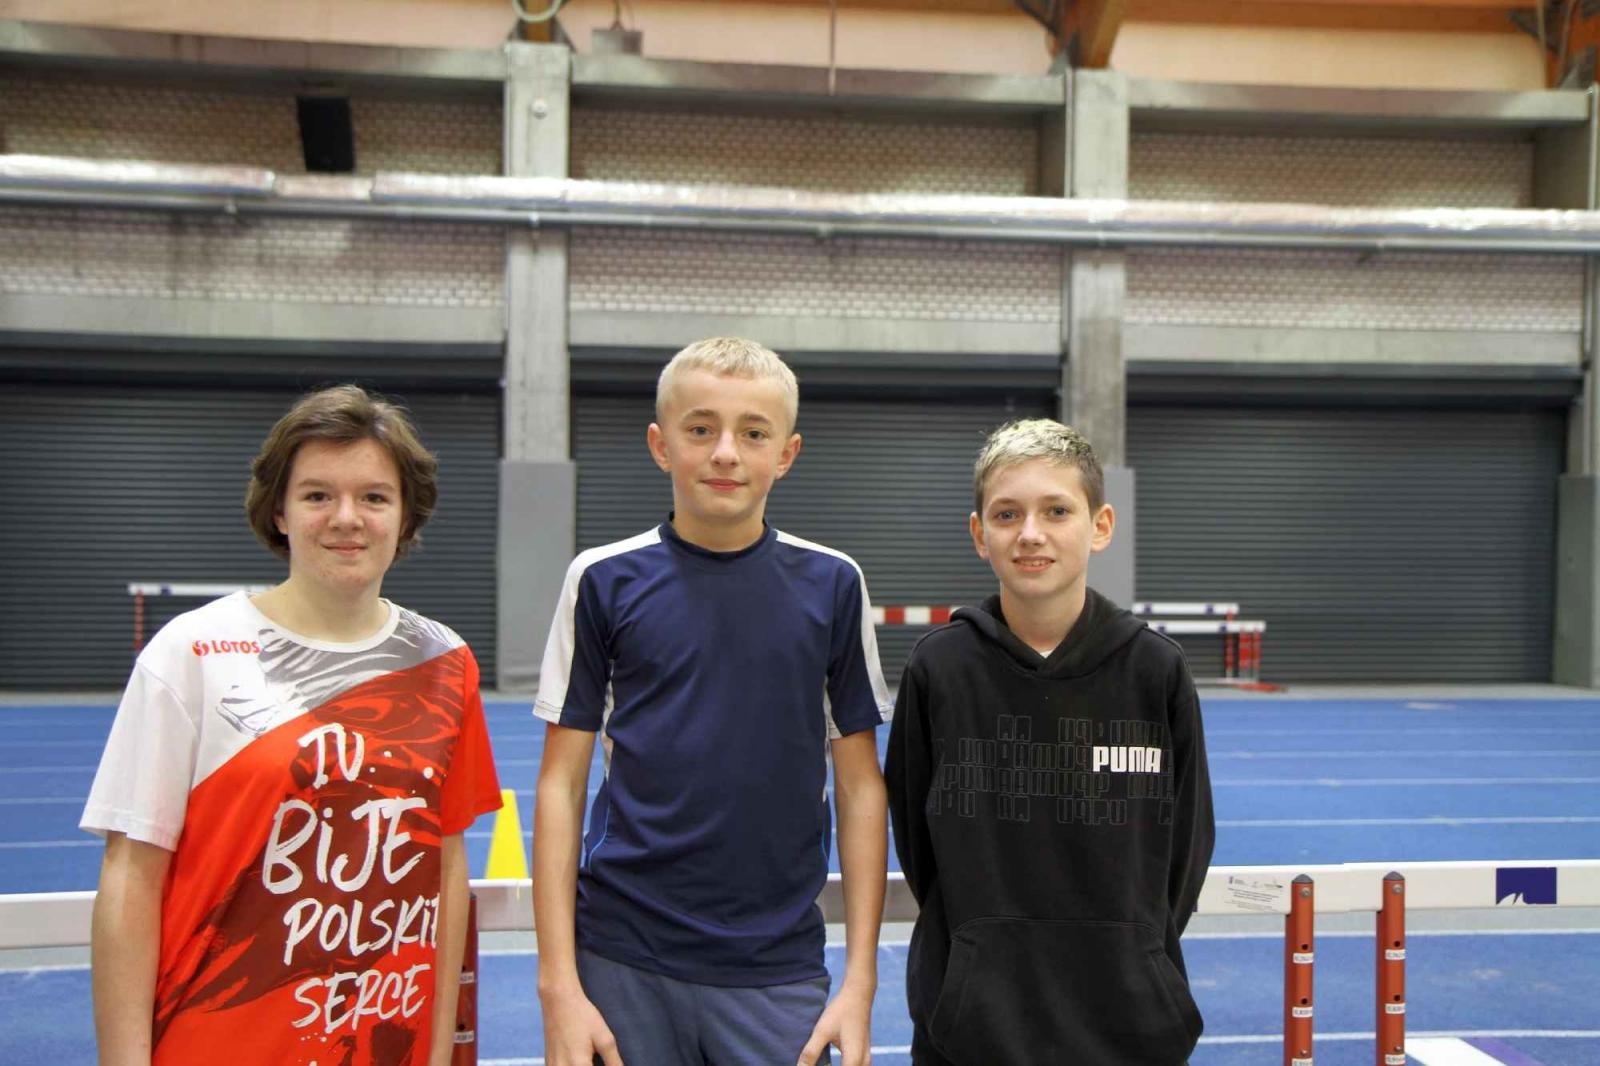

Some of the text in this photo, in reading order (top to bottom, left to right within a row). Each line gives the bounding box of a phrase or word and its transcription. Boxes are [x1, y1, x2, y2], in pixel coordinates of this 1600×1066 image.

[211, 640, 260, 654] LOTOS
[1093, 746, 1162, 773] PUMA
[291, 963, 431, 1034] SERCE
